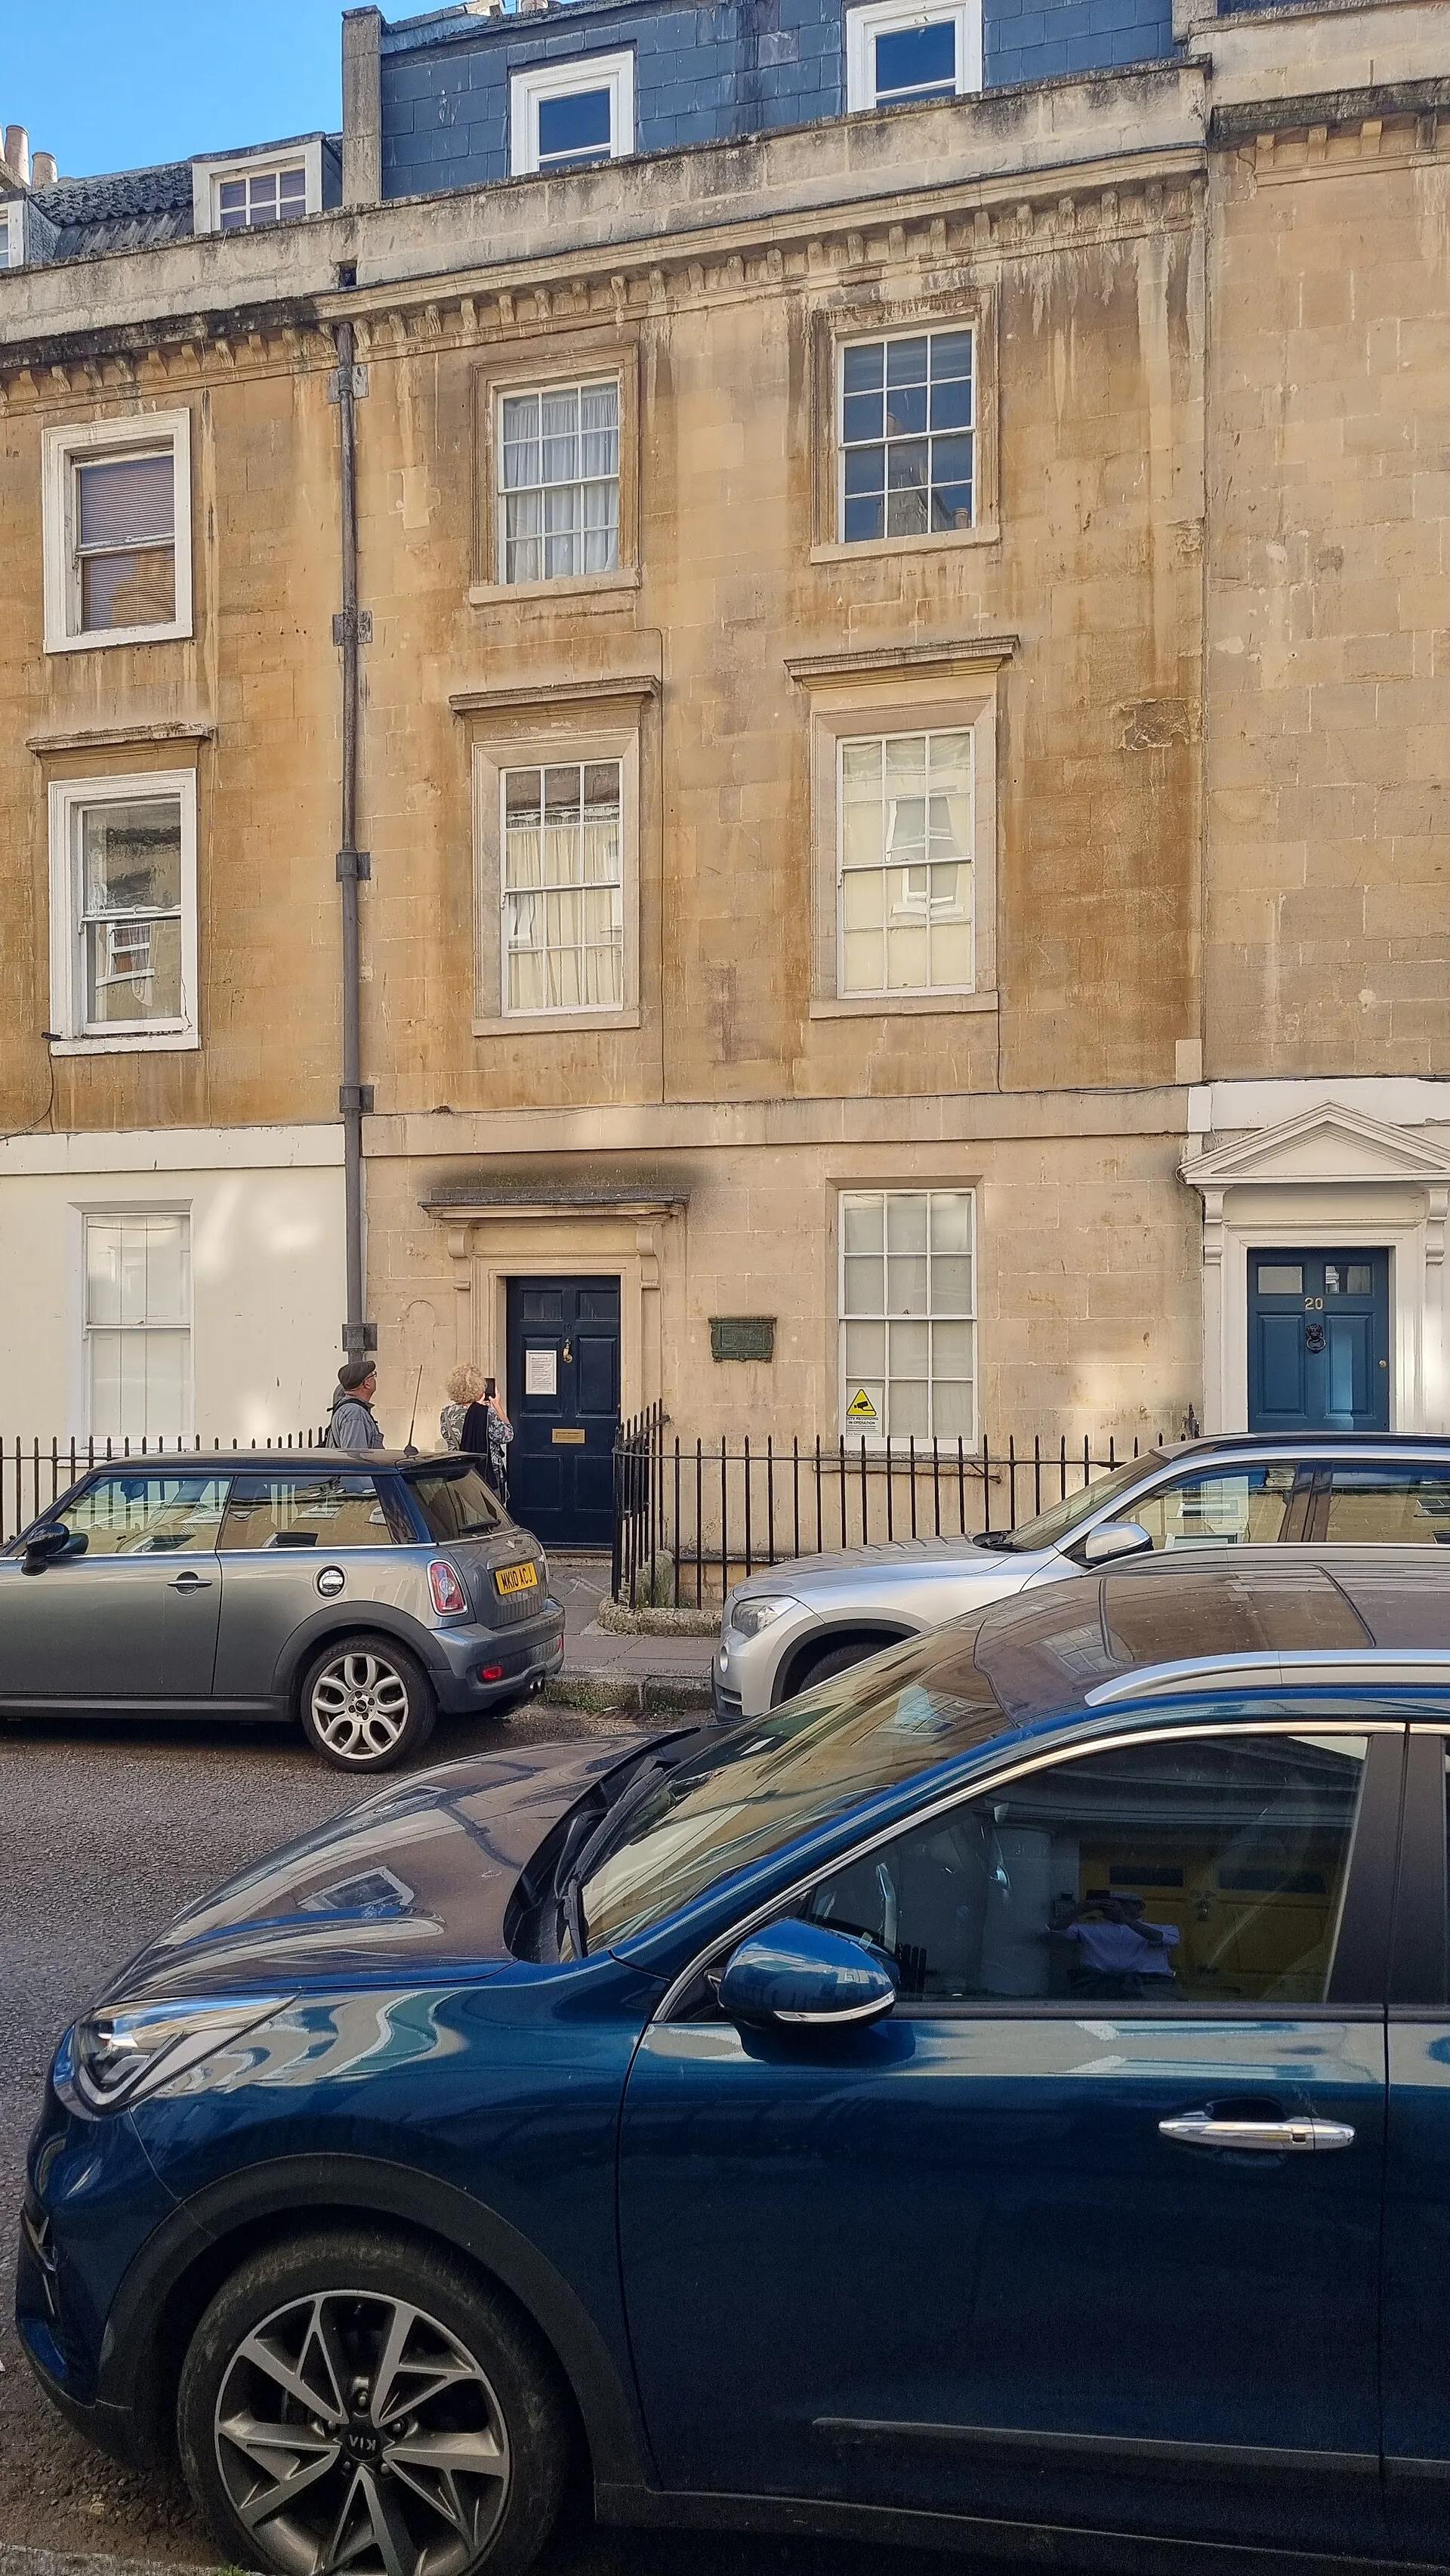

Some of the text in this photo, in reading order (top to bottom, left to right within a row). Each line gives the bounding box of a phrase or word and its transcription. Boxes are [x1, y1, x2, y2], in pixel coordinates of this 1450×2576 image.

[1304, 1297, 1323, 1310] 20
[519, 1566, 533, 1586] ACJ
[349, 2434, 376, 2451] KIA
